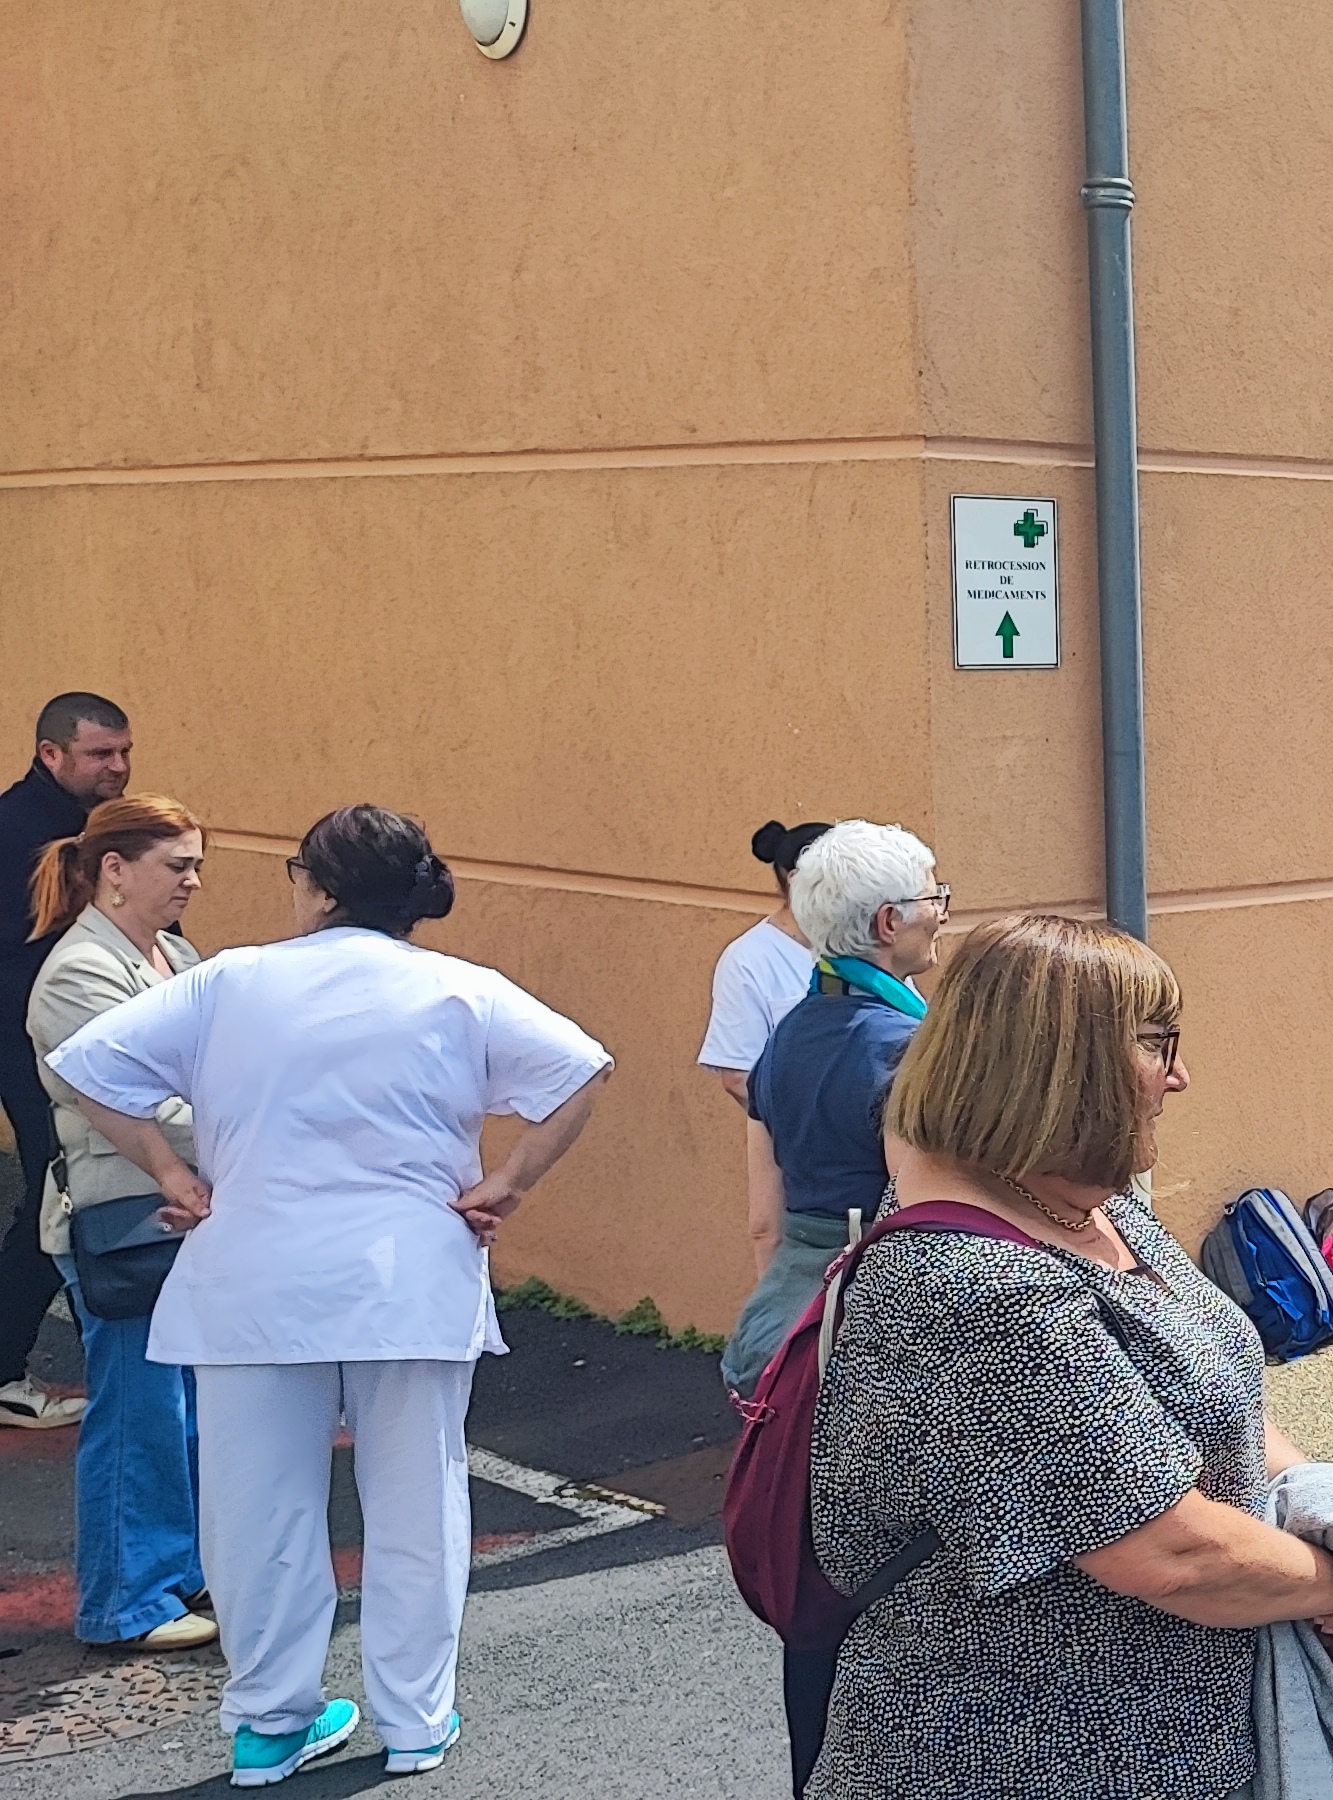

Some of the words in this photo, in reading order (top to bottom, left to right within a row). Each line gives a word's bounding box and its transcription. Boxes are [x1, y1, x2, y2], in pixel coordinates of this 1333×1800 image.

[965, 559, 1047, 571] RETROCESSION
[1000, 575, 1014, 585] DE
[967, 589, 1047, 600] MEDICAMENTS
